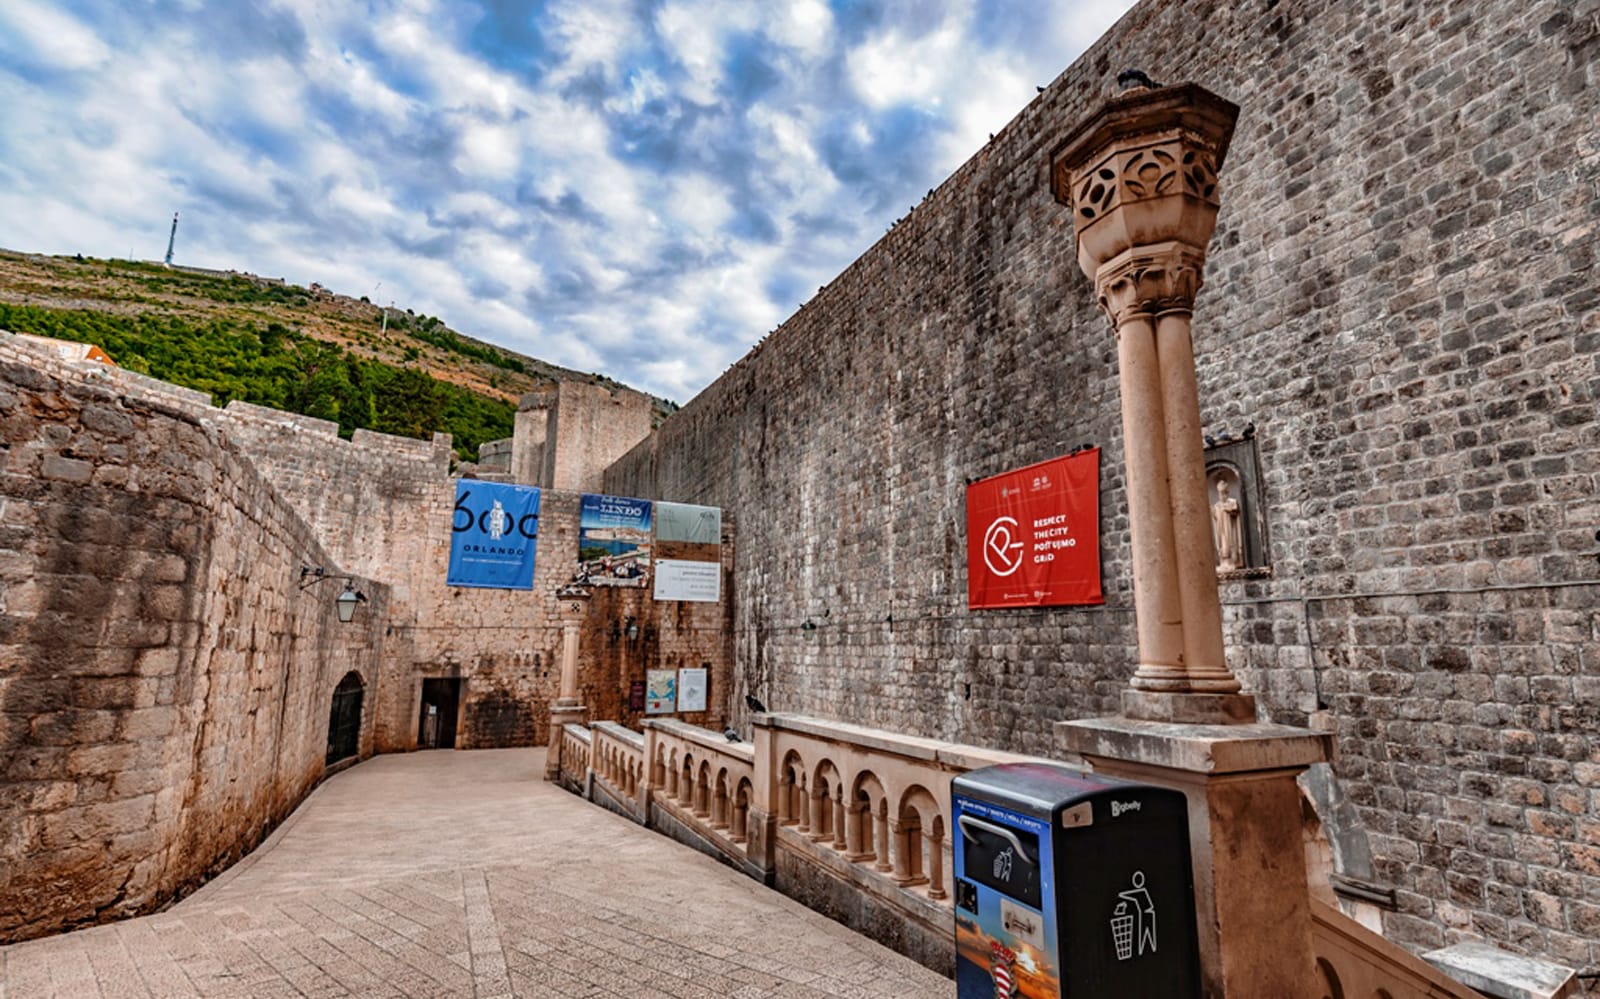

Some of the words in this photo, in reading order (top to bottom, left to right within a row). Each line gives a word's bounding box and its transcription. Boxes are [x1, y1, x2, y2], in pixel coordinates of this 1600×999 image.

[1033, 514, 1066, 528] RESPECT
[1034, 530, 1048, 539] THE
[1049, 527, 1068, 537] CITY
[463, 544, 525, 556] ORLANDO
